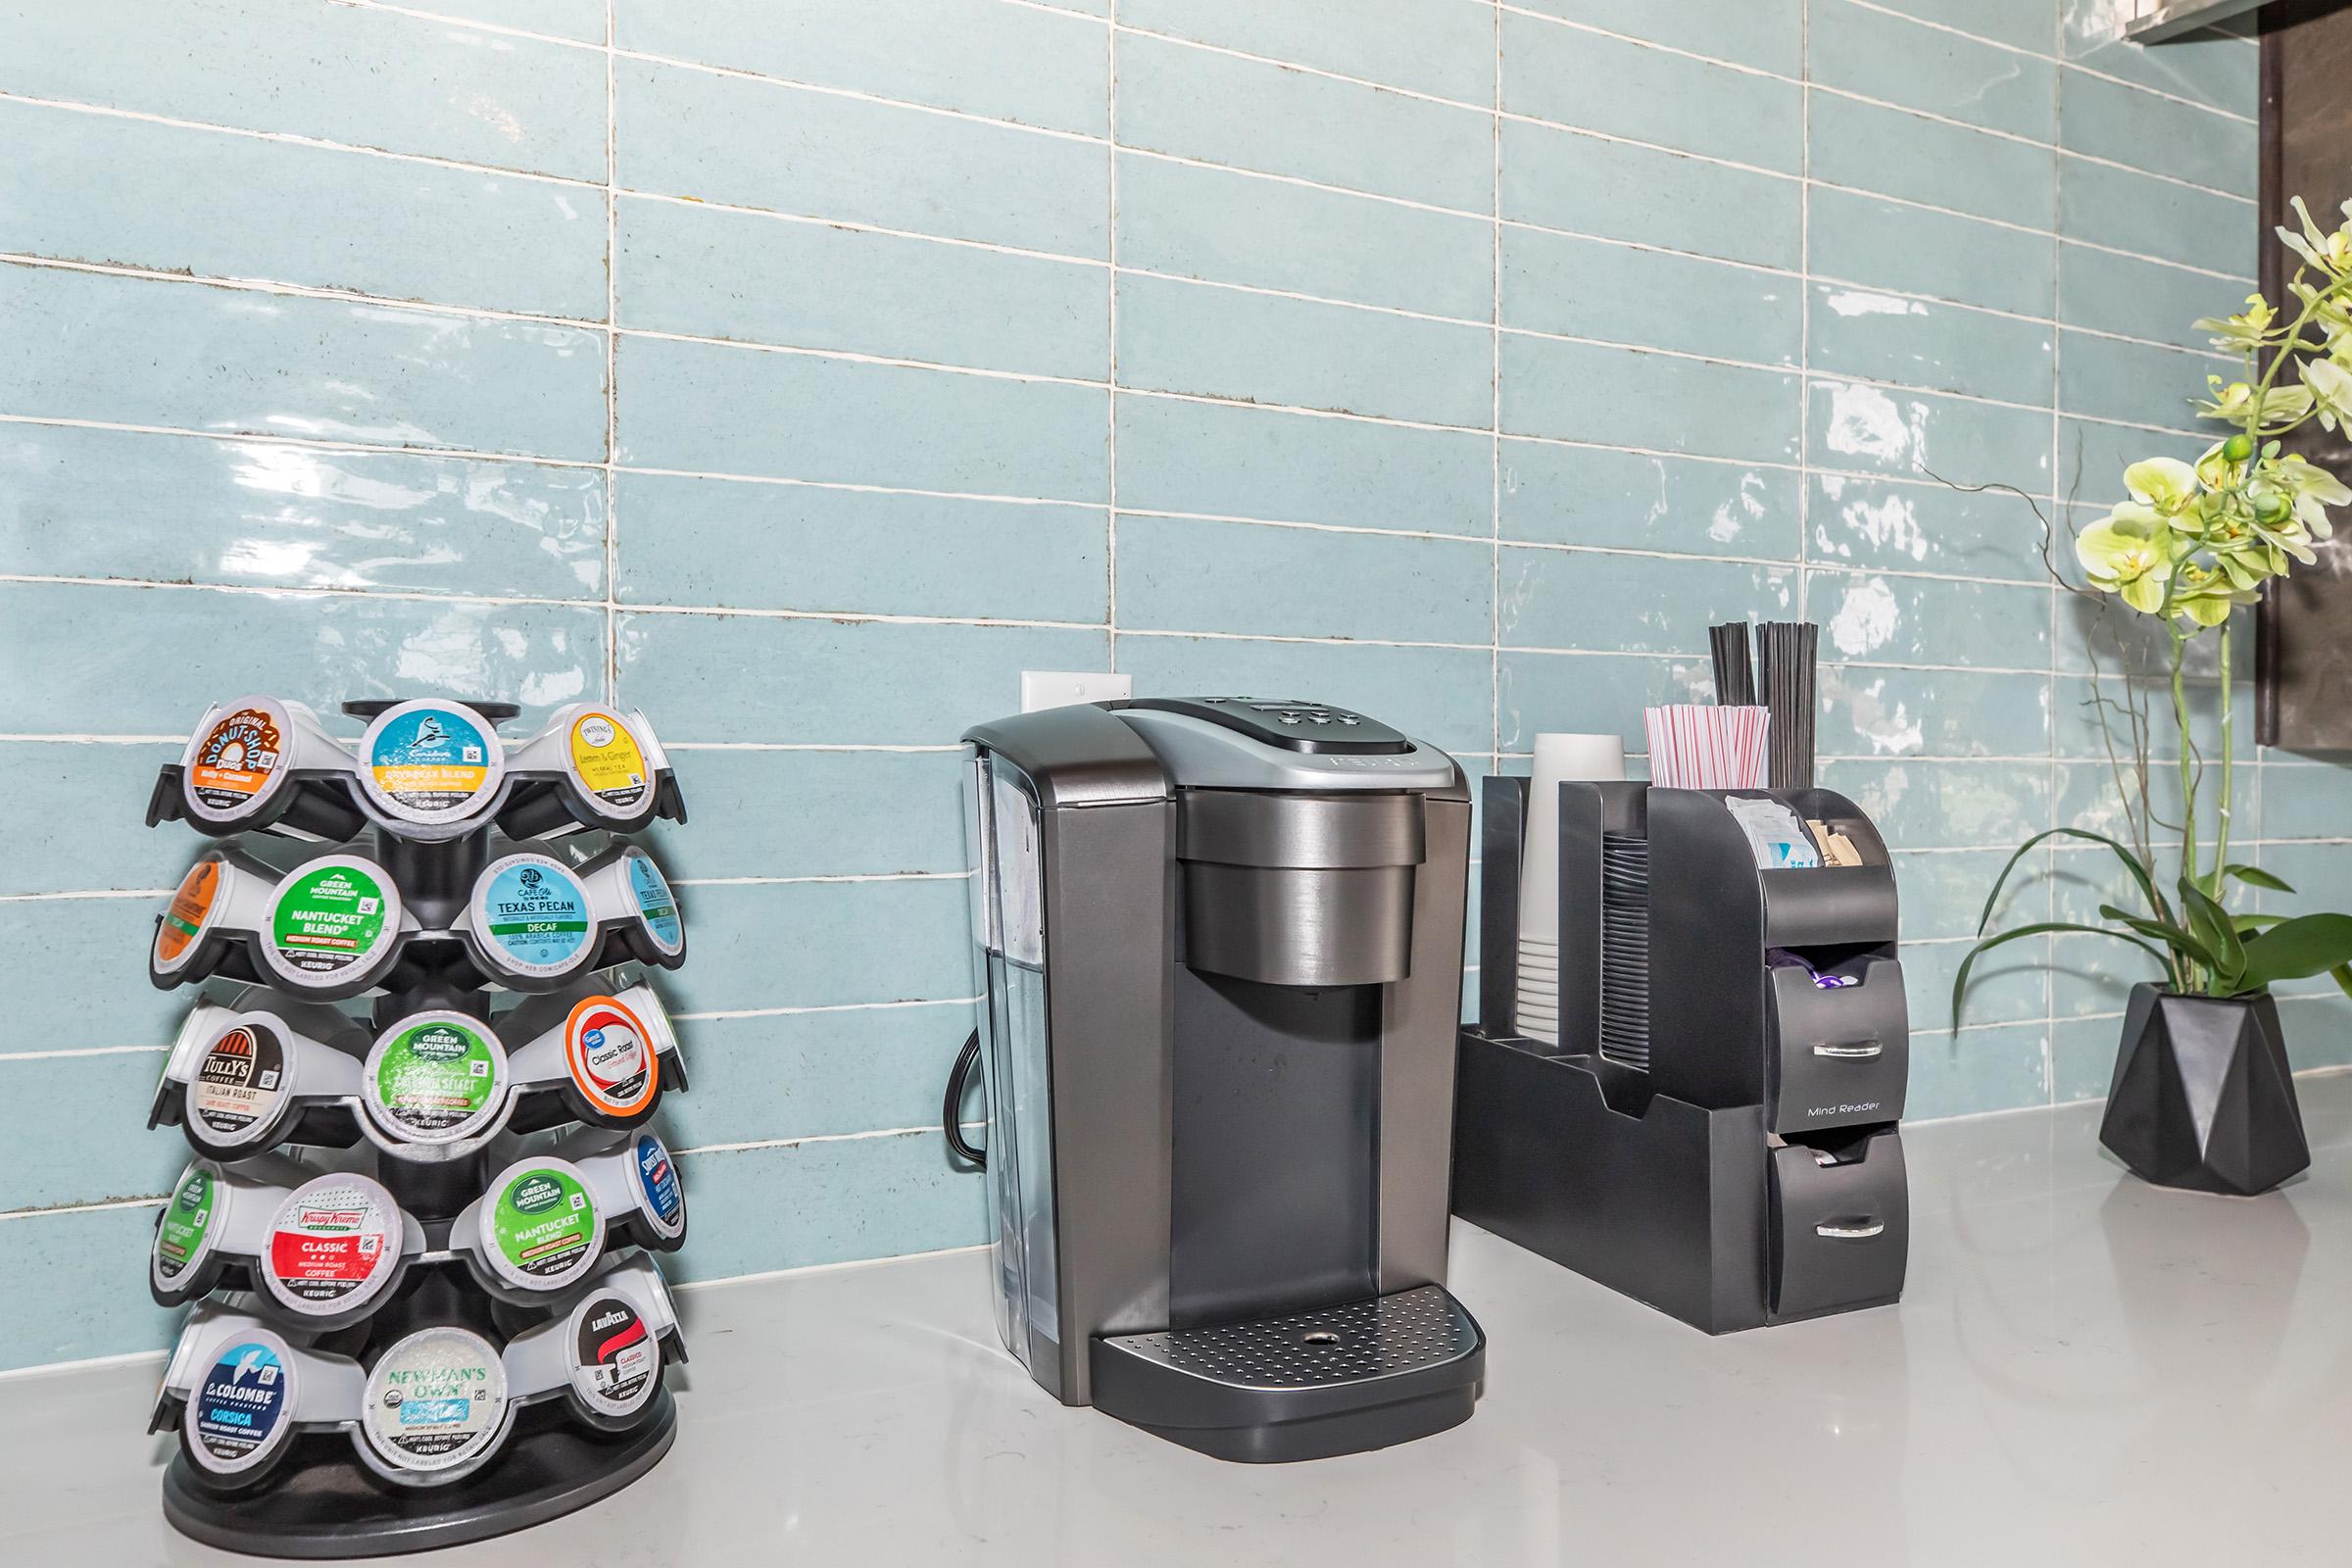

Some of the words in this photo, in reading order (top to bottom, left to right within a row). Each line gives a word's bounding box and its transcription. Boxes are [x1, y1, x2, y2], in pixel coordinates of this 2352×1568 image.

[229, 715, 266, 730] ORIGINAL
[244, 730, 261, 769] SHOP
[608, 751, 632, 762] Ginger
[441, 769, 475, 779] BLEND
[311, 888, 358, 897] MOUNTAIN
[499, 903, 535, 912] TEXAS
[539, 902, 574, 911] PECAN
[292, 910, 365, 925] NANTUCKET
[527, 923, 558, 932] DECAF
[422, 1035, 459, 1044] GREEN
[414, 1043, 466, 1052] MOUNTAIN
[592, 1050, 618, 1065] Classic
[617, 1041, 634, 1054] Roast
[207, 1085, 230, 1096] ITALIAN
[233, 1086, 257, 1101] ROAST
[1808, 1106, 1837, 1117] Mind
[1839, 1102, 1880, 1113] Reader
[520, 1183, 551, 1197] GREEN
[515, 1188, 561, 1207] MOUNTAIN
[301, 1212, 332, 1224] Krispy
[330, 1212, 362, 1224] Kreme
[514, 1213, 579, 1242] NANTUCKET
[302, 1242, 348, 1252] CLASSIC
[545, 1259, 573, 1273] KEURIG
[591, 1310, 629, 1332] LAVAZZA
[620, 1351, 642, 1364] CLASSICO
[388, 1367, 486, 1384] NEWMAN'S
[216, 1384, 273, 1404] COLOMBE
[415, 1385, 459, 1397] OWN
[211, 1408, 252, 1426] CORSICA
[238, 1428, 263, 1437] COFFEE
[416, 1444, 451, 1452] KEURIG
